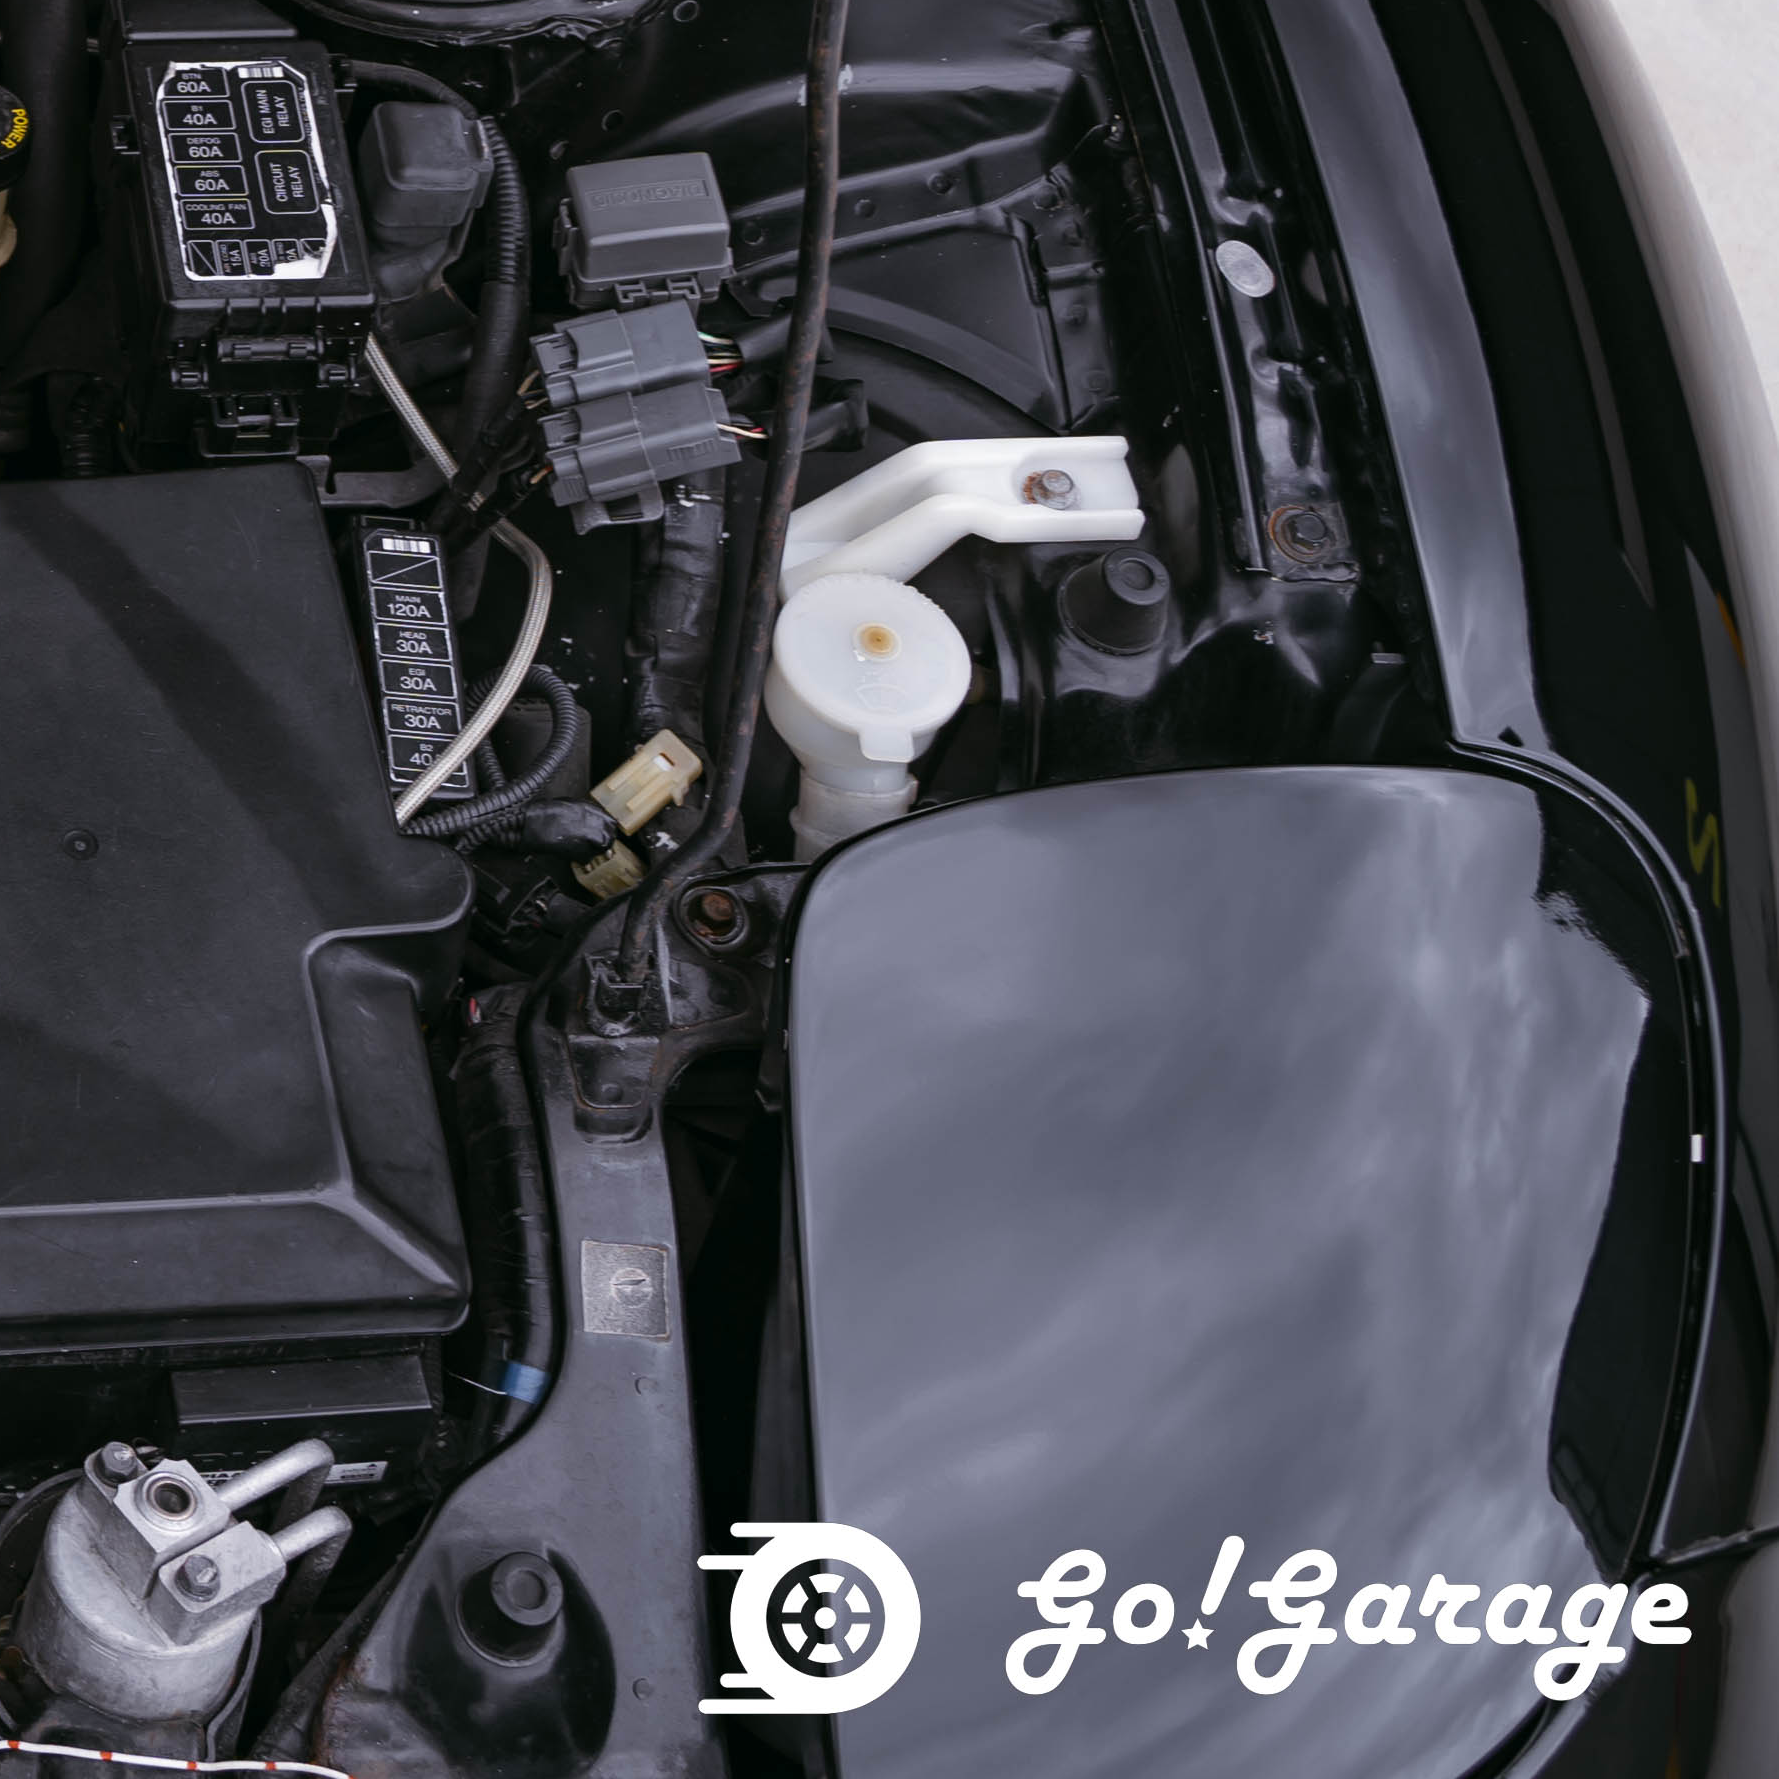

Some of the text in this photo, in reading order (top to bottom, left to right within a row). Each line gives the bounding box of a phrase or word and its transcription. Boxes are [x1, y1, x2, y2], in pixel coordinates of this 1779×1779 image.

[176, 80, 211, 93] 60A
[257, 89, 275, 135] EGI MAIN
[274, 95, 290, 128] RELAY
[182, 113, 217, 125] 40A
[1, 108, 29, 149] POWER
[186, 137, 221, 145] DEFOG
[188, 145, 223, 158] 60A
[200, 170, 220, 178] ABS
[194, 179, 229, 191] 60A
[271, 162, 288, 202] CIRCUIT
[289, 165, 306, 198] RELAY
[185, 203, 247, 212] COOLING FAN
[201, 212, 236, 225] 40A
[395, 594, 421, 604] MAIN
[387, 602, 432, 619] 120A
[399, 630, 427, 640] HEAD
[395, 639, 433, 655] 30A
[408, 667, 426, 677] EGI
[399, 676, 437, 692] 30A
[391, 703, 453, 717] RETRACTOR
[403, 714, 442, 730] 30A
[409, 752, 439, 767] 40
